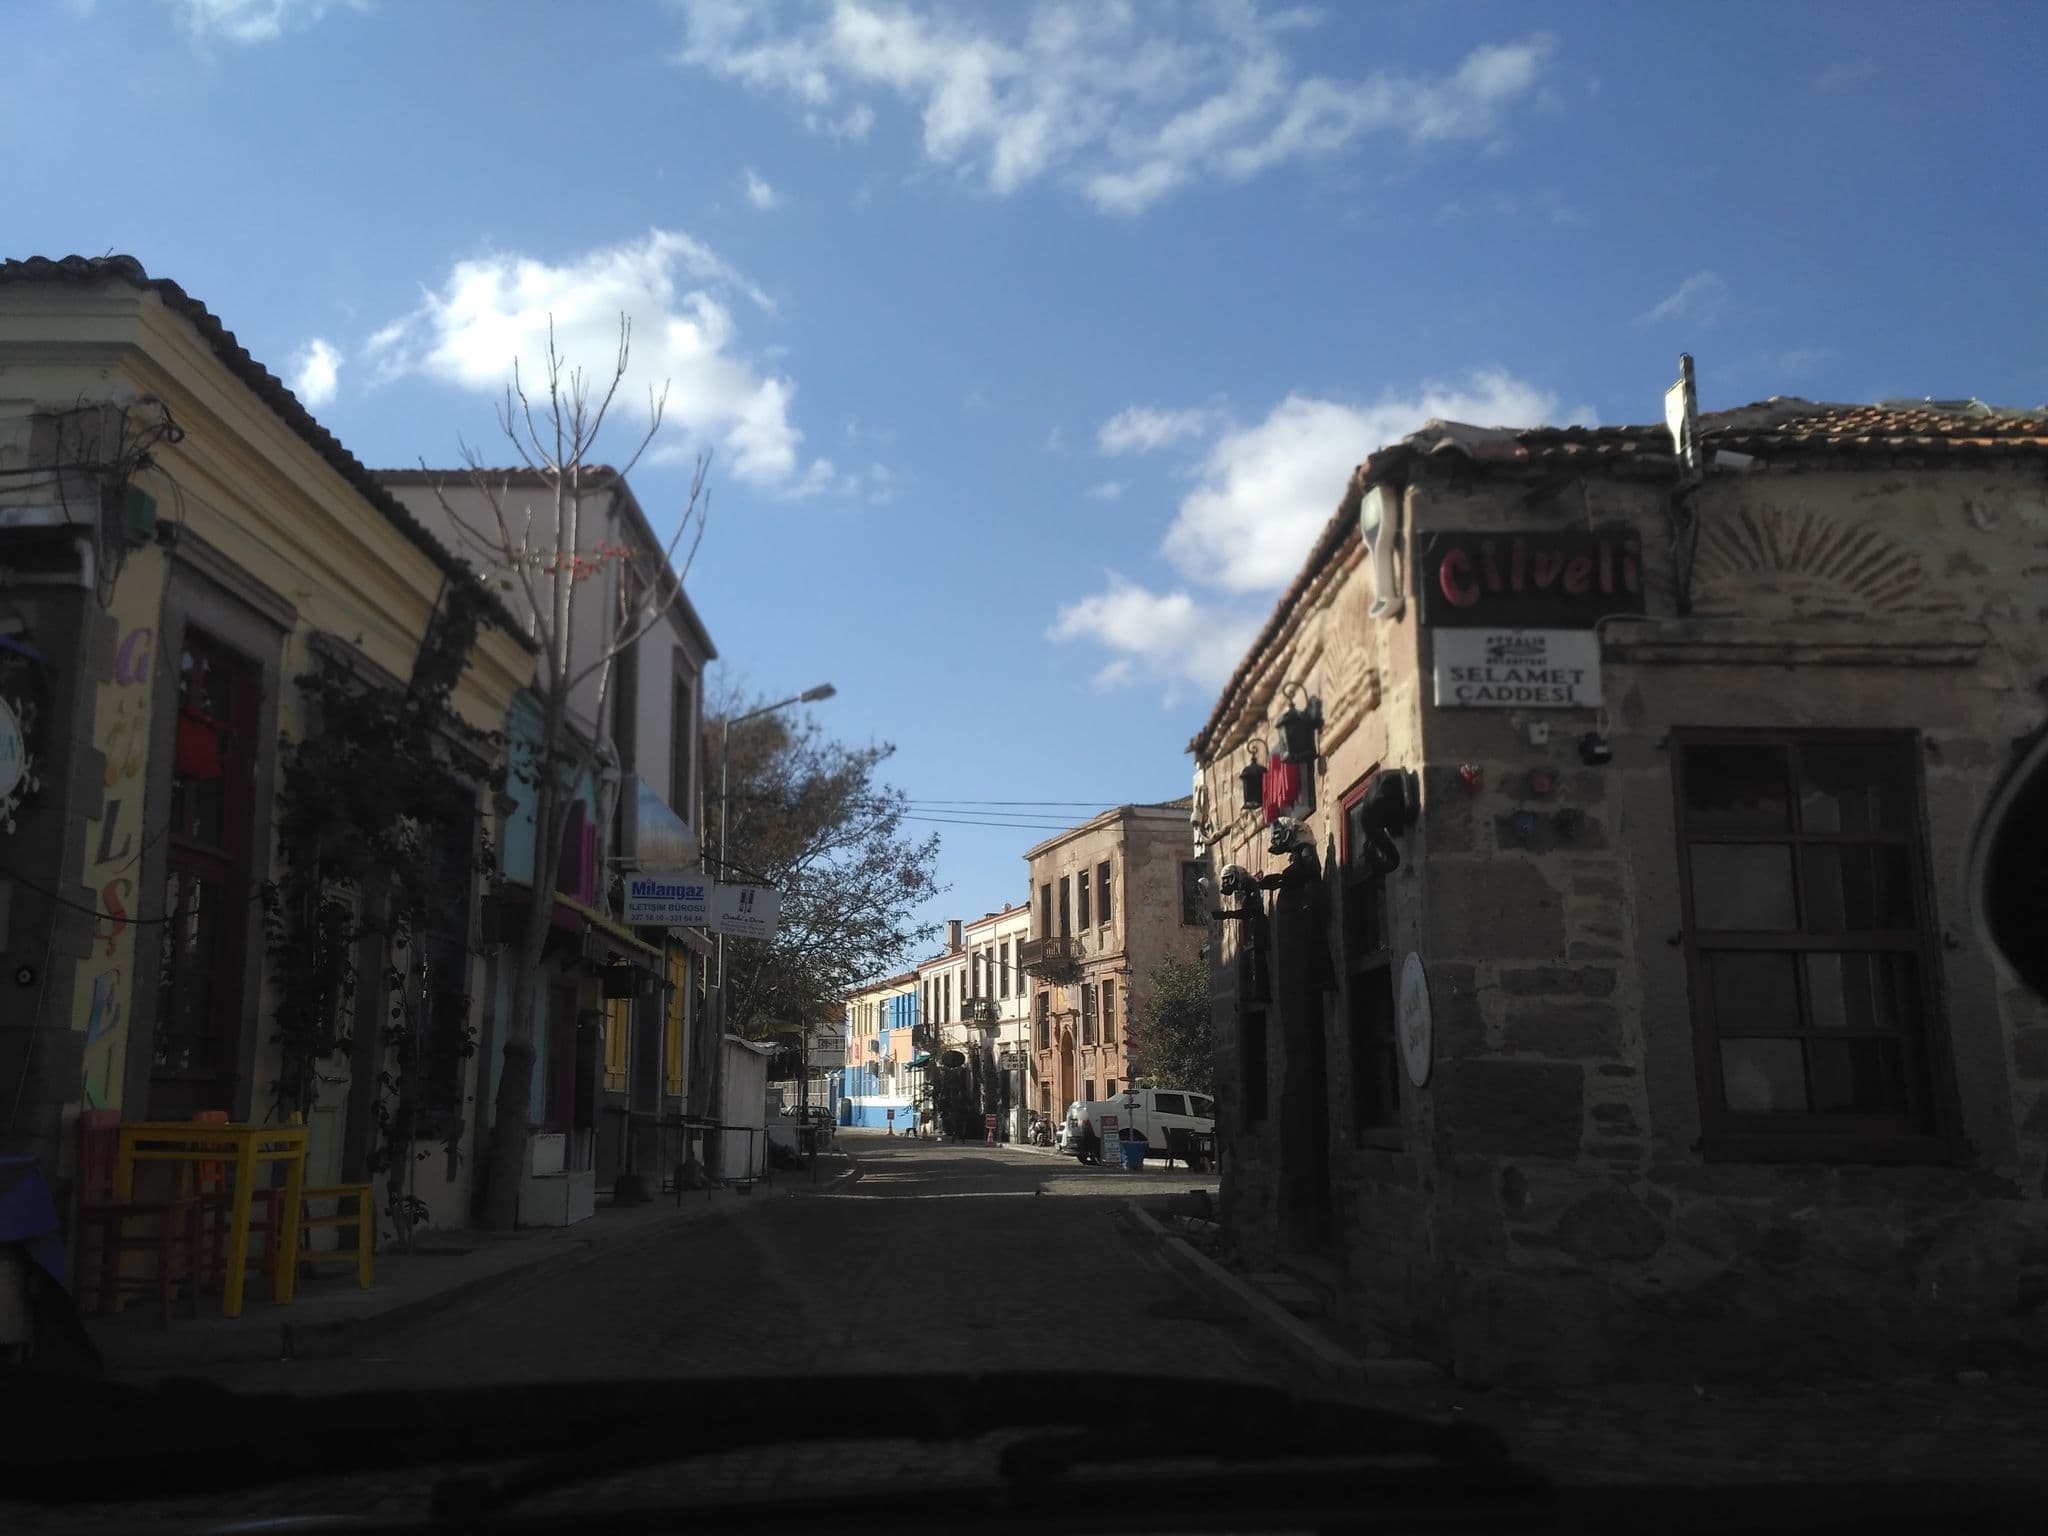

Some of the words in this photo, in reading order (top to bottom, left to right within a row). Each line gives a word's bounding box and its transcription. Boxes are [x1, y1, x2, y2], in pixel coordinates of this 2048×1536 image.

[1450, 666, 1585, 684] SELAMET
[1455, 685, 1574, 702] CADDESİ
[632, 881, 704, 899] Milangaz
